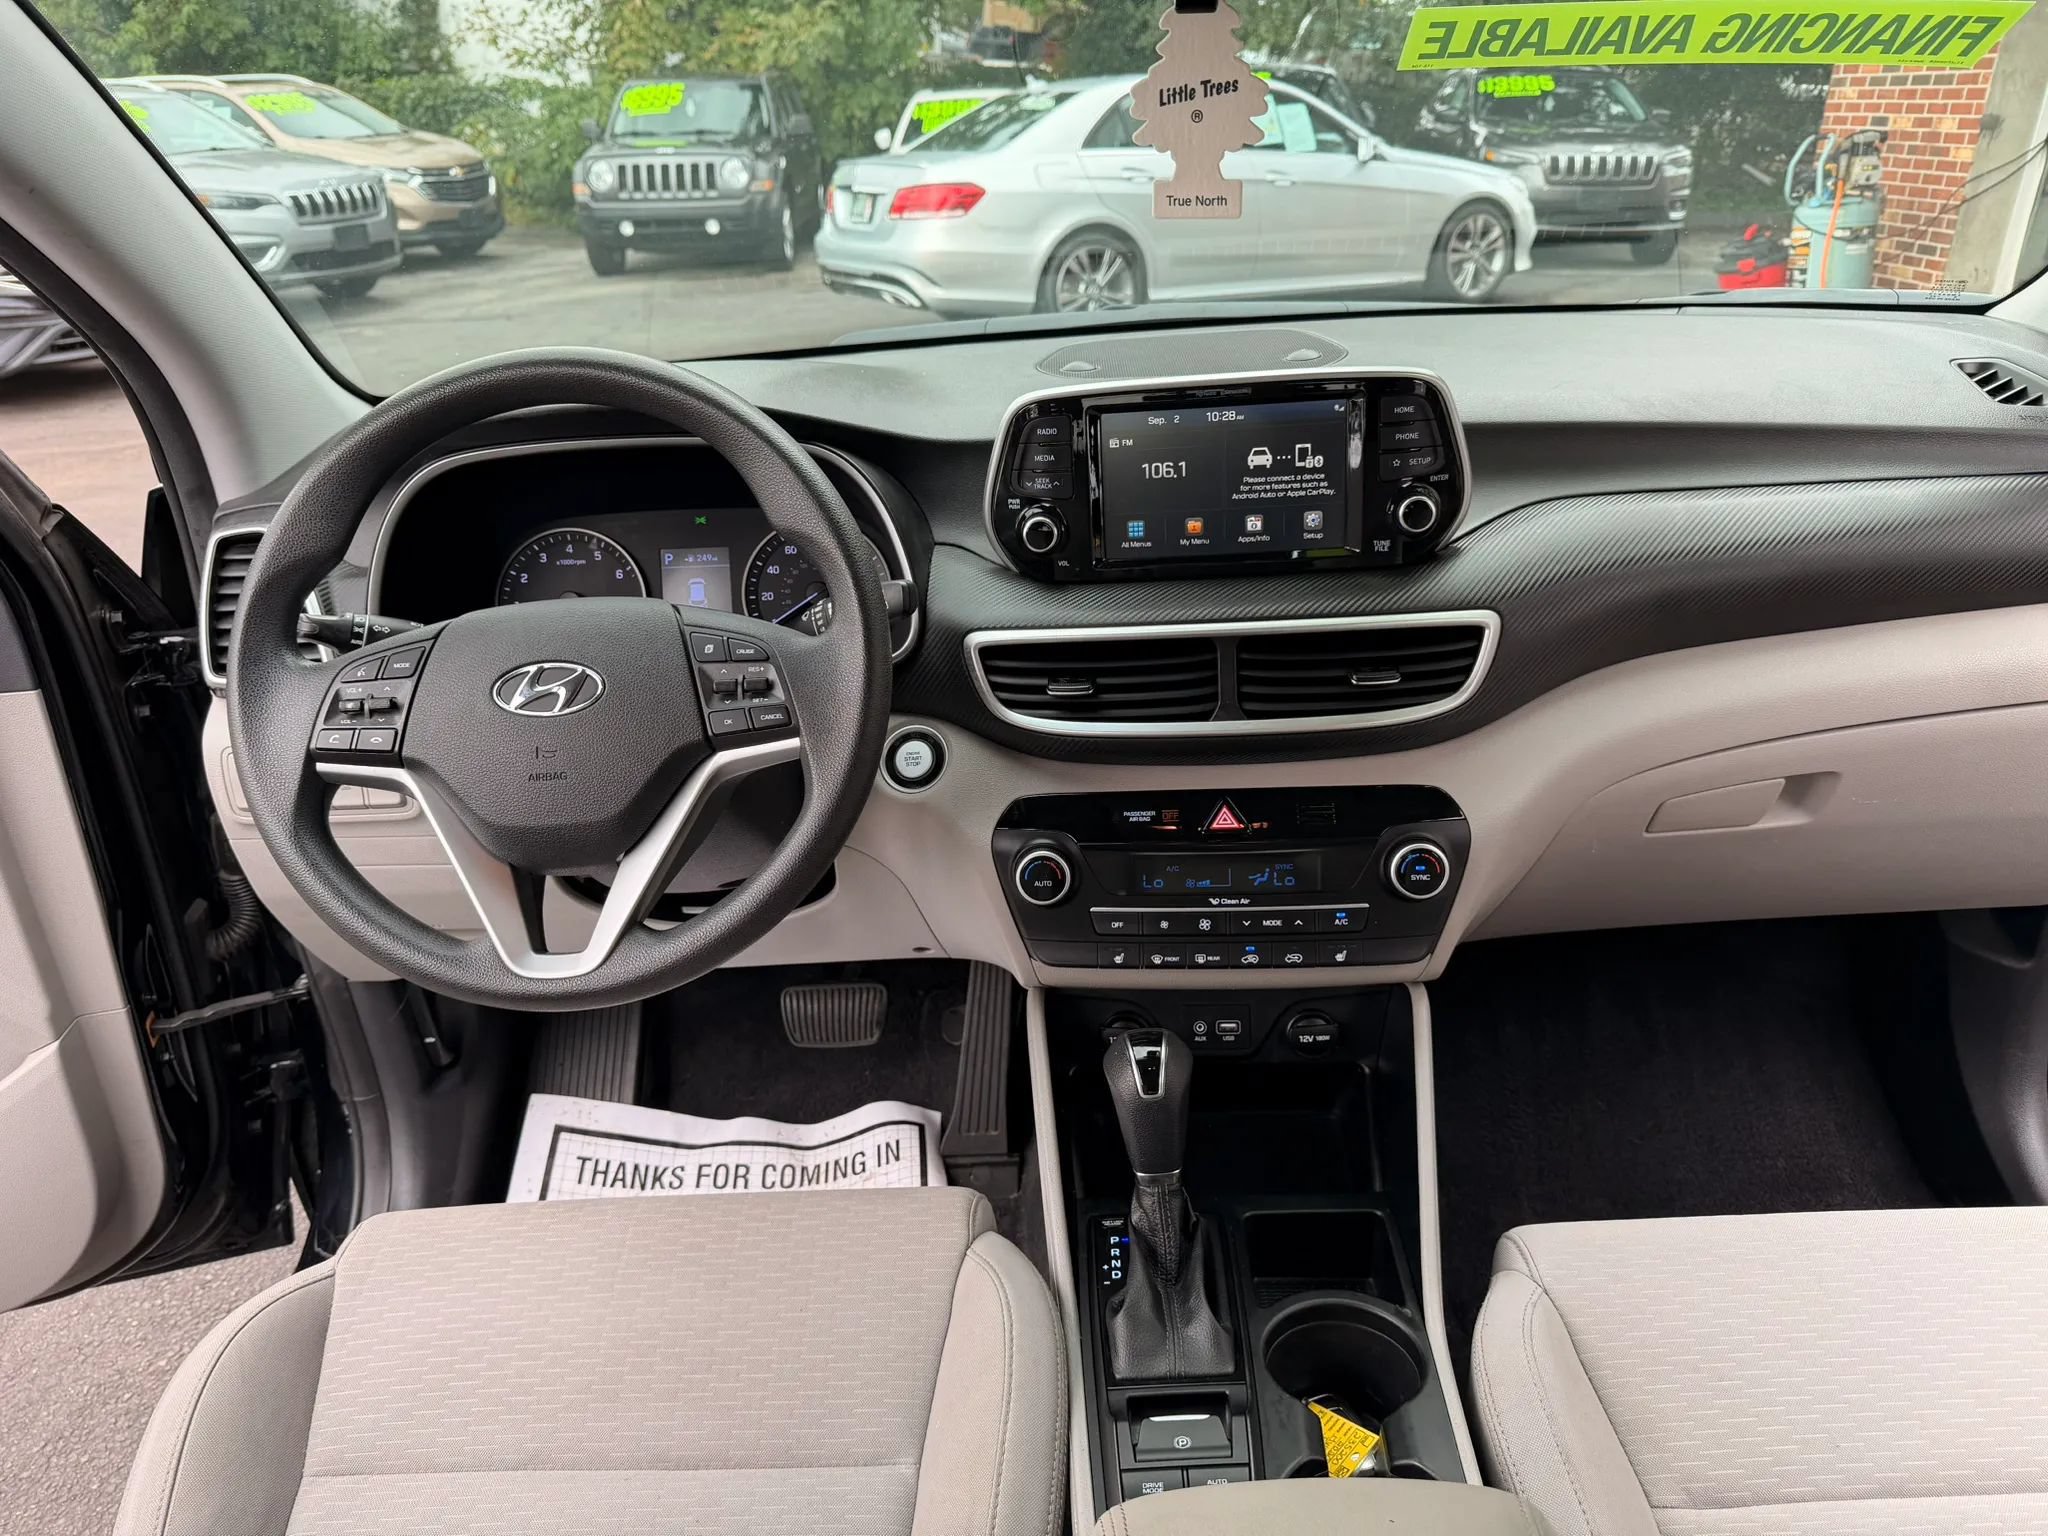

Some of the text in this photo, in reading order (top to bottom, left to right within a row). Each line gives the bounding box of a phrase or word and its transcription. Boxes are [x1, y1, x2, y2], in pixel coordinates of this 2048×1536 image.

[1159, 79, 1239, 107] Little Trees
[1166, 195, 1228, 207] True North
[1394, 405, 1415, 414] HOME
[1148, 415, 1180, 426] Sep. 2
[1206, 410, 1236, 422] 10:28
[1037, 428, 1057, 436] RADIO
[1395, 432, 1419, 441] PHONE
[1122, 439, 1133, 447] FM
[1409, 457, 1431, 466] SETUP
[1141, 461, 1187, 480] 106.1
[1267, 474, 1295, 482] connect
[1430, 474, 1449, 482] ENTER
[1272, 482, 1301, 490] features
[1232, 492, 1259, 500] Android
[1287, 489, 1306, 498] Apple
[1307, 488, 1337, 496] CarPlay.
[1237, 533, 1271, 543] Apps/Info
[1303, 531, 1324, 542] Setup
[1121, 540, 1152, 549] All Menus
[1180, 537, 1210, 547] My Menu
[566, 544, 573, 553] 4
[784, 546, 797, 554] 60
[539, 553, 547, 563] 3
[594, 551, 601, 561] 5
[664, 553, 673, 565] P
[615, 569, 624, 579] 6
[767, 565, 780, 574] 40
[520, 573, 529, 583] 2
[761, 592, 774, 601] 20
[528, 771, 568, 782] AIRBAG
[1162, 811, 1180, 821] OFF
[1262, 919, 1283, 927] MODE
[1334, 918, 1348, 926] A/C
[1299, 1035, 1314, 1043] 12V
[576, 1139, 901, 1191] THANKS FOR COMING IN
[1110, 1236, 1120, 1244] P
[1111, 1248, 1120, 1257] R
[1111, 1260, 1121, 1268] N
[1112, 1270, 1122, 1279] D
